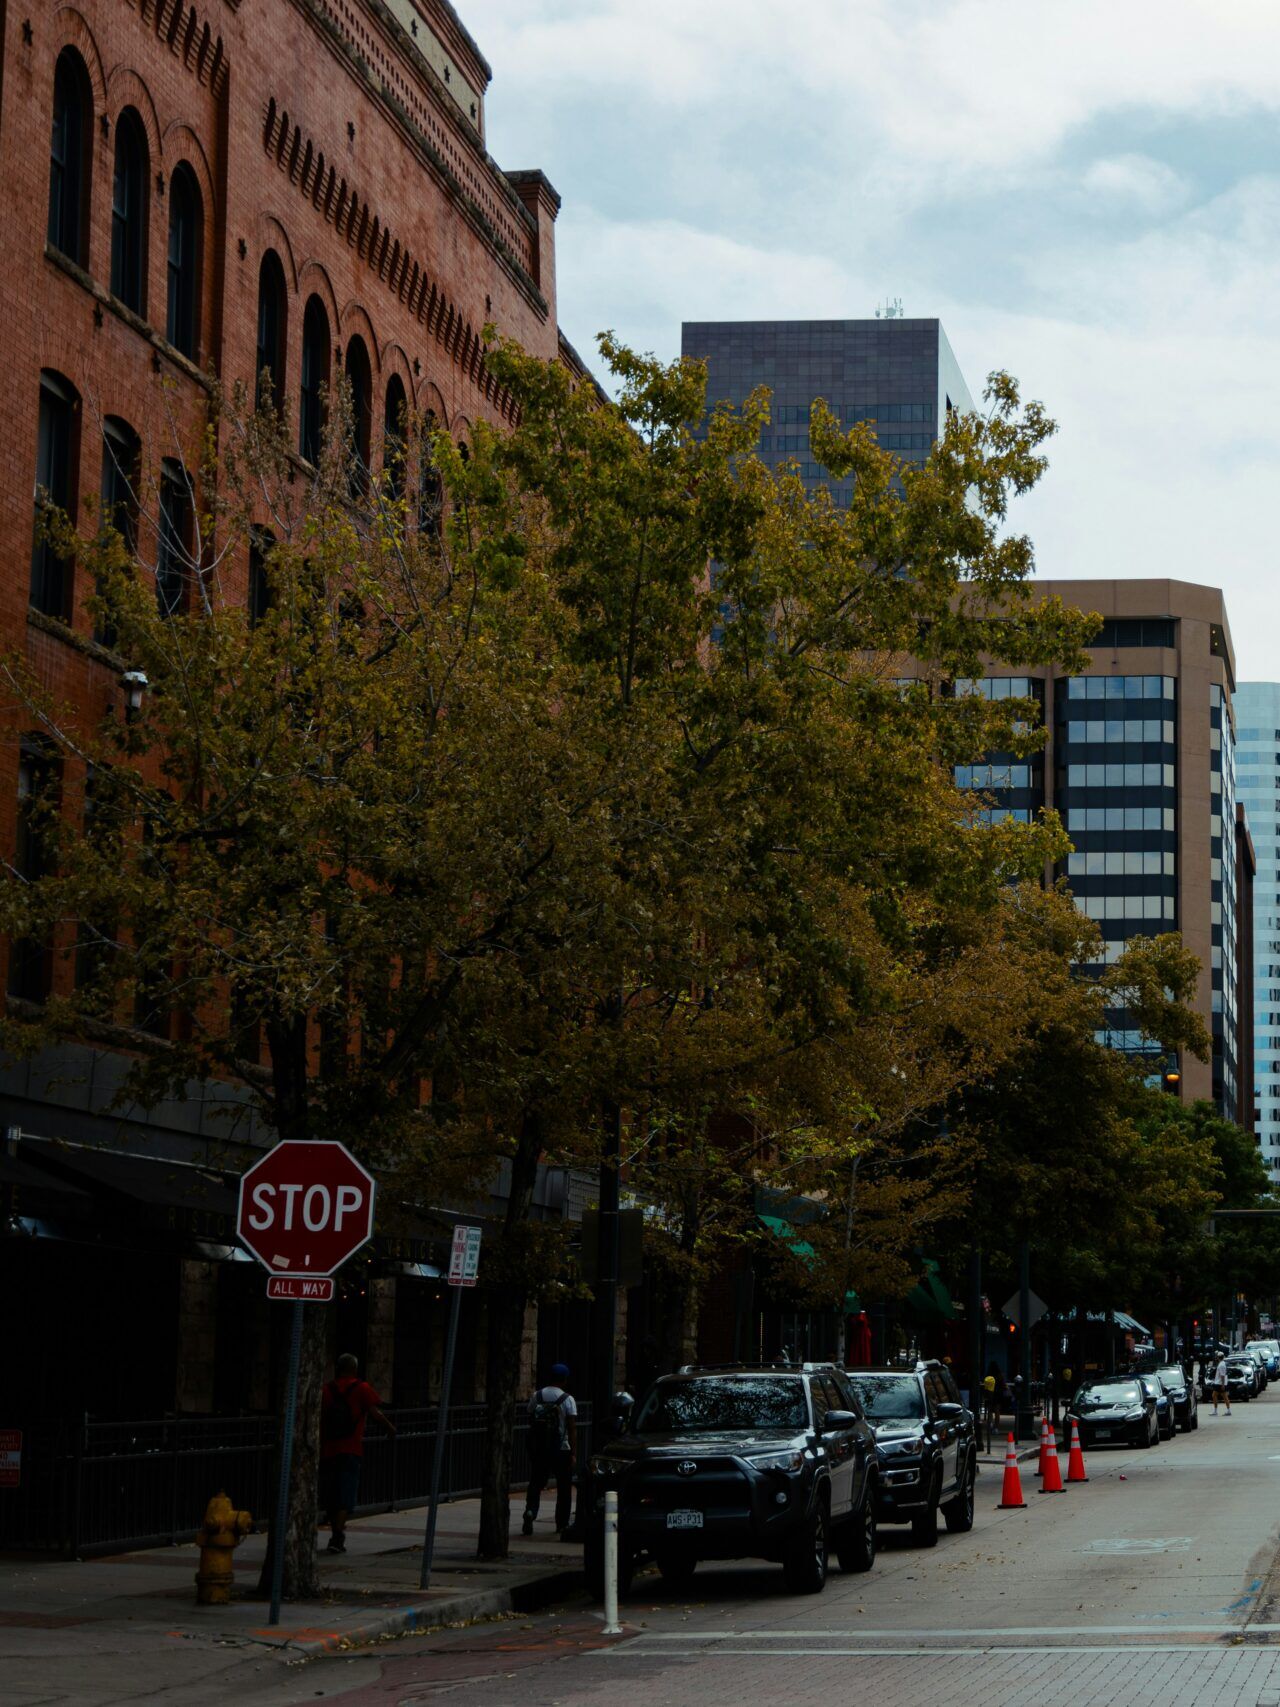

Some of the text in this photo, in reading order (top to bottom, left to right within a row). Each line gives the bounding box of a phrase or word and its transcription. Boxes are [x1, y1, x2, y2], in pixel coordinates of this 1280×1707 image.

[248, 1182, 363, 1232] STOP
[273, 1281, 327, 1296] ALL WAY
